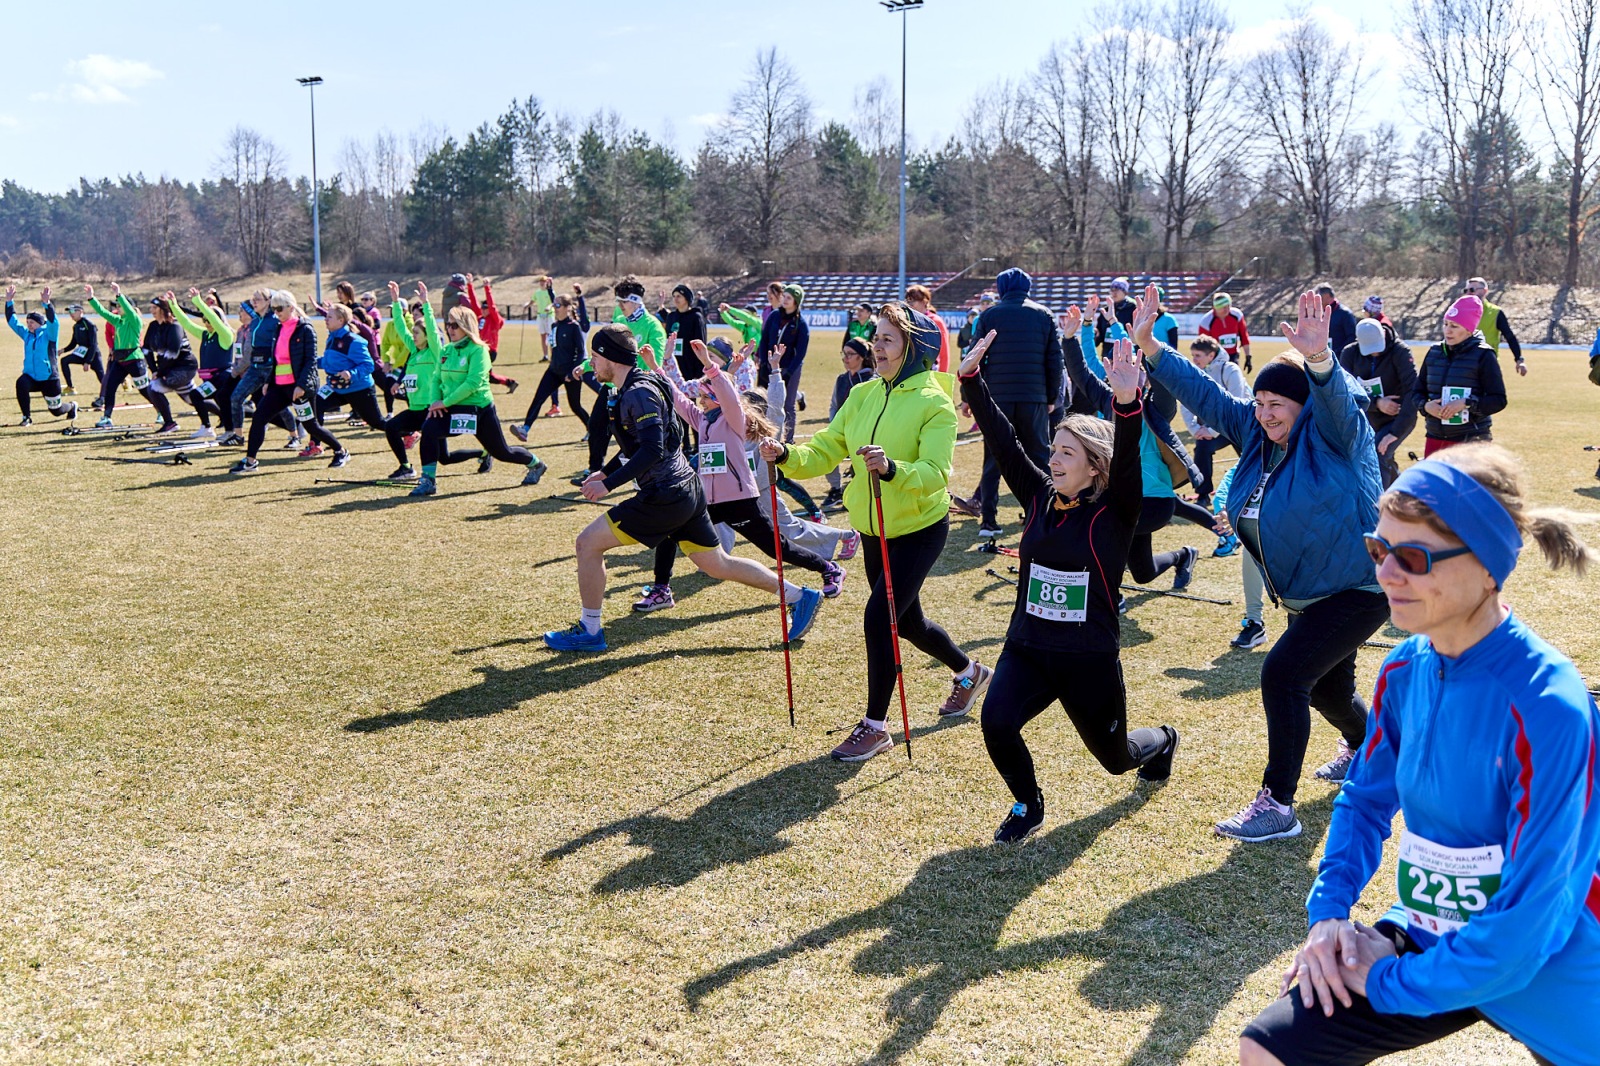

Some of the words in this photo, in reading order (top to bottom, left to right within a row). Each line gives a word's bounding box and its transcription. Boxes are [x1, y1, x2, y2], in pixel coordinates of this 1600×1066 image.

[811, 311, 840, 326] ZDRÓJ
[457, 419, 469, 428] 37
[1040, 582, 1067, 604] 86
[1455, 854, 1492, 863] WALKING
[1444, 862, 1478, 870] BOCIANA
[1408, 866, 1488, 911] 225
